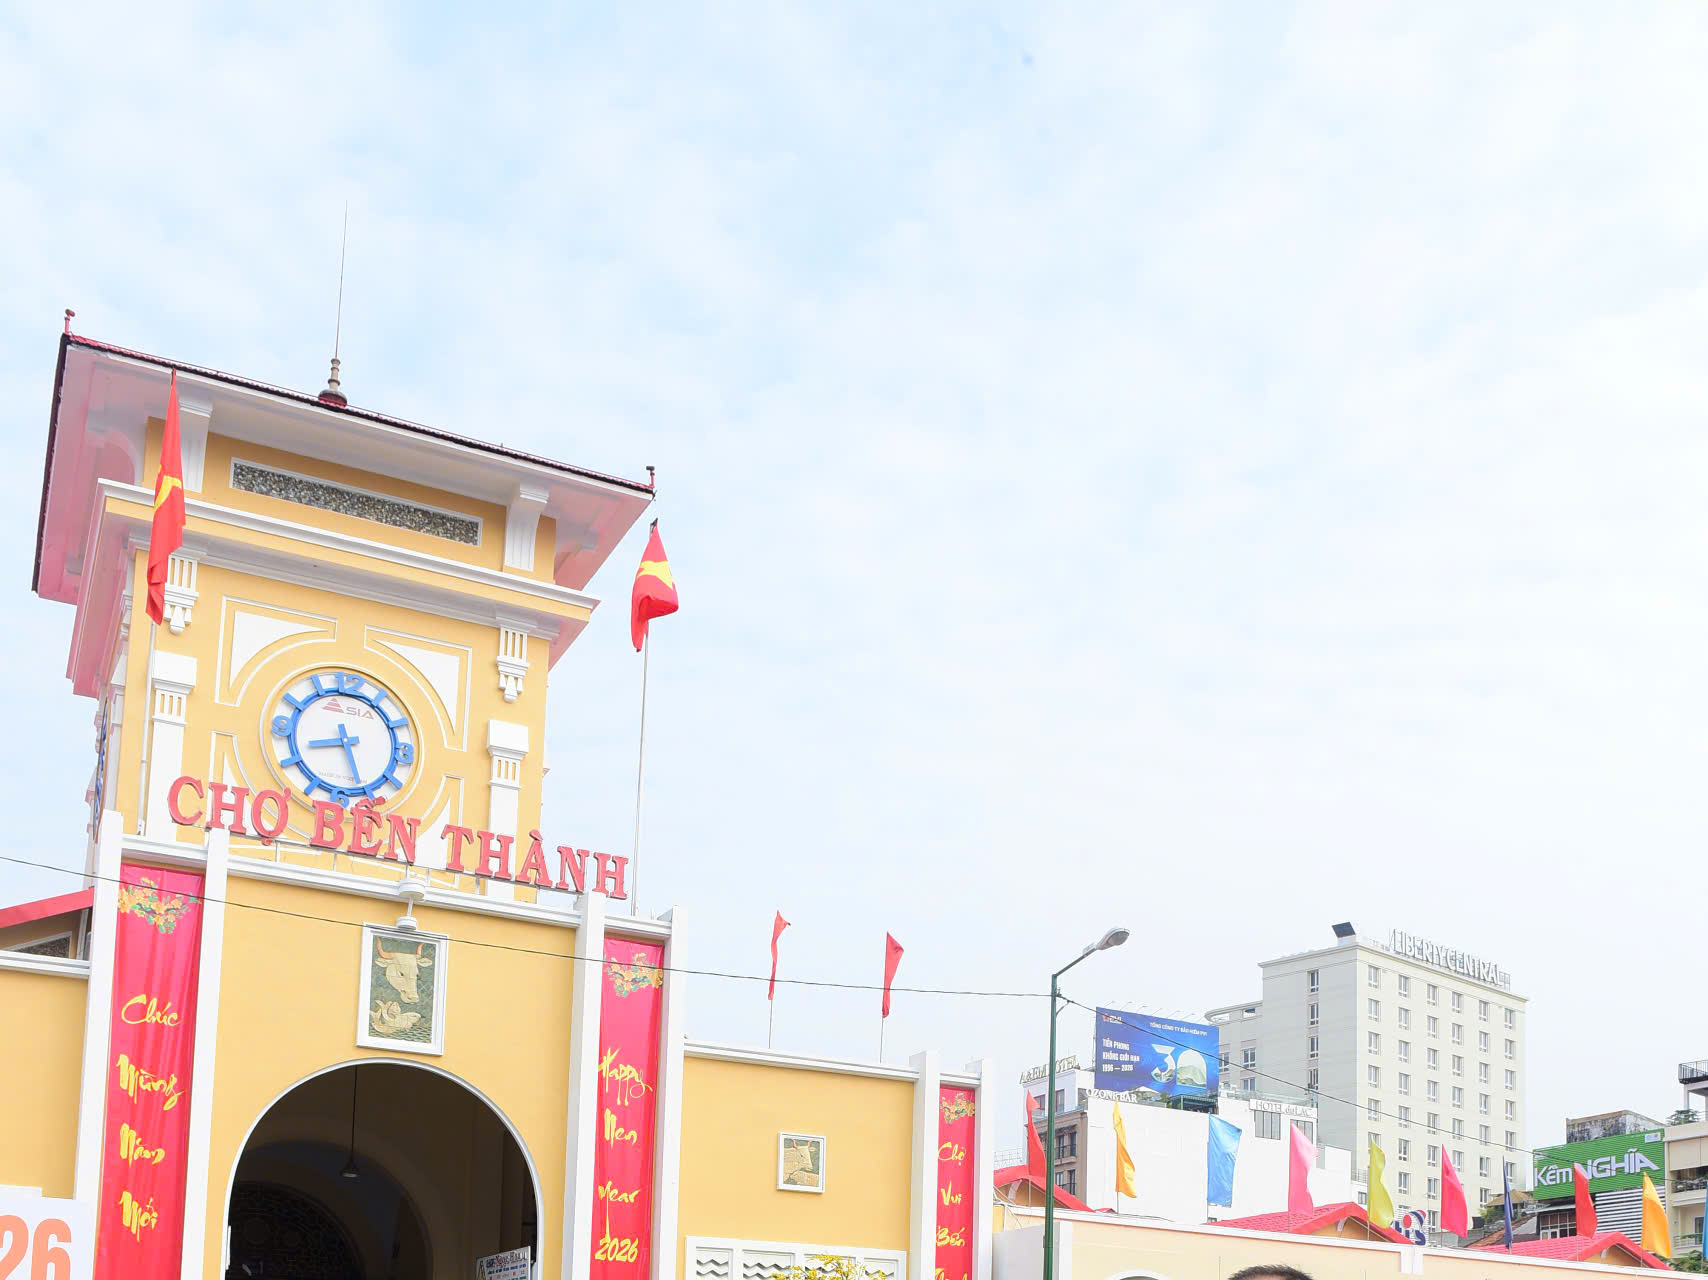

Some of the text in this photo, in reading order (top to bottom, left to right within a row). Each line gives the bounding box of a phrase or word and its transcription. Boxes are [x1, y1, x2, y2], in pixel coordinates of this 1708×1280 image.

[335, 671, 366, 697] 12
[272, 715, 293, 737] 9
[395, 742, 415, 764] 3
[168, 775, 629, 900] CHỢ BẾN THÀNH
[1389, 928, 1504, 986] LIBERTY CENTRAL
[121, 994, 182, 1025] Chúc
[598, 1047, 653, 1106] Happy
[1055, 1055, 1078, 1074] OTEL
[116, 1054, 184, 1110] Mừng
[1120, 1091, 1138, 1103] BAR
[1255, 1101, 1282, 1112] HOTEL
[937, 1142, 966, 1166] Chợ
[940, 1181, 962, 1206] Vui
[935, 1225, 966, 1247] Bến
[595, 1238, 639, 1263] 2026
